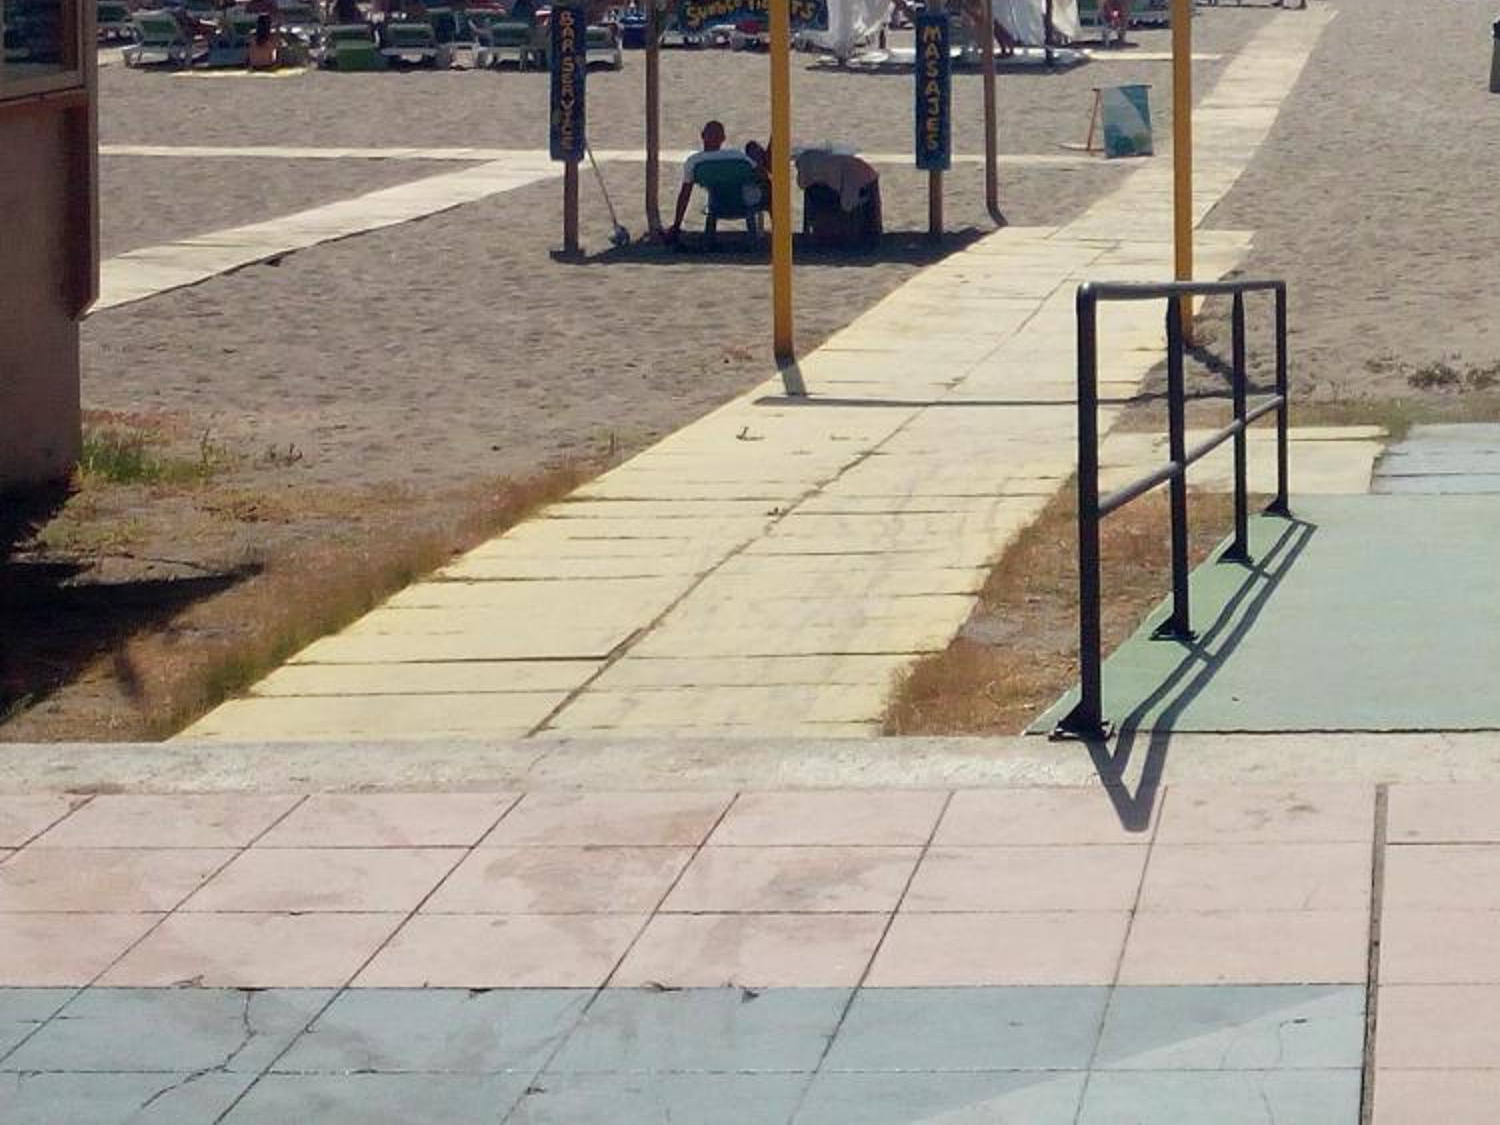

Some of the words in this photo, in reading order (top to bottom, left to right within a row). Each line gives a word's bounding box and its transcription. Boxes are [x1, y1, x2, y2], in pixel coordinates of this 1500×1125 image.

[560, 10, 576, 54] BAR
[560, 56, 576, 151] SERVICE
[923, 26, 942, 151] MASAJES
